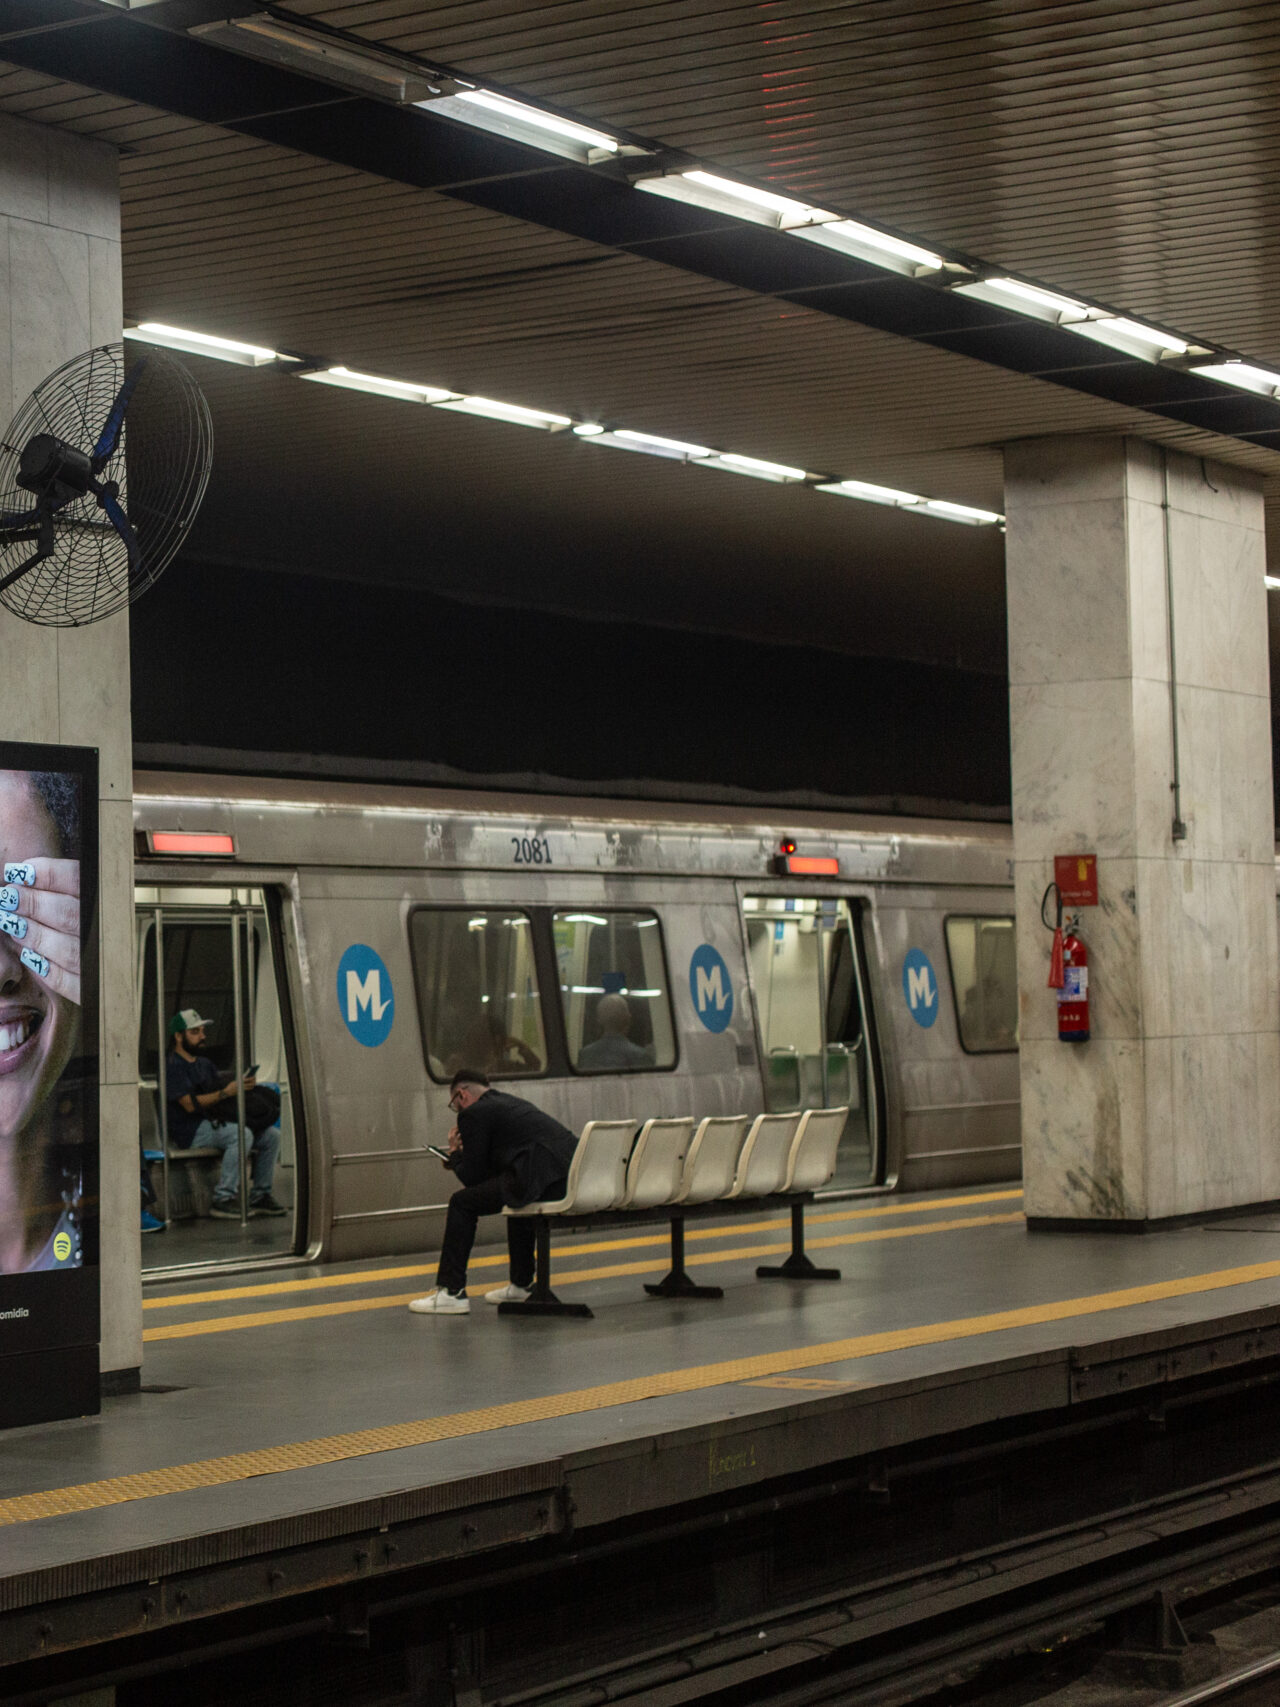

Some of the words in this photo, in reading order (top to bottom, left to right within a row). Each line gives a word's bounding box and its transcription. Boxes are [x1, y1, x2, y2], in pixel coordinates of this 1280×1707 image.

[511, 837, 553, 864] 2081
[346, 969, 392, 1022] M
[696, 965, 730, 1012] M
[908, 966, 936, 1010] M
